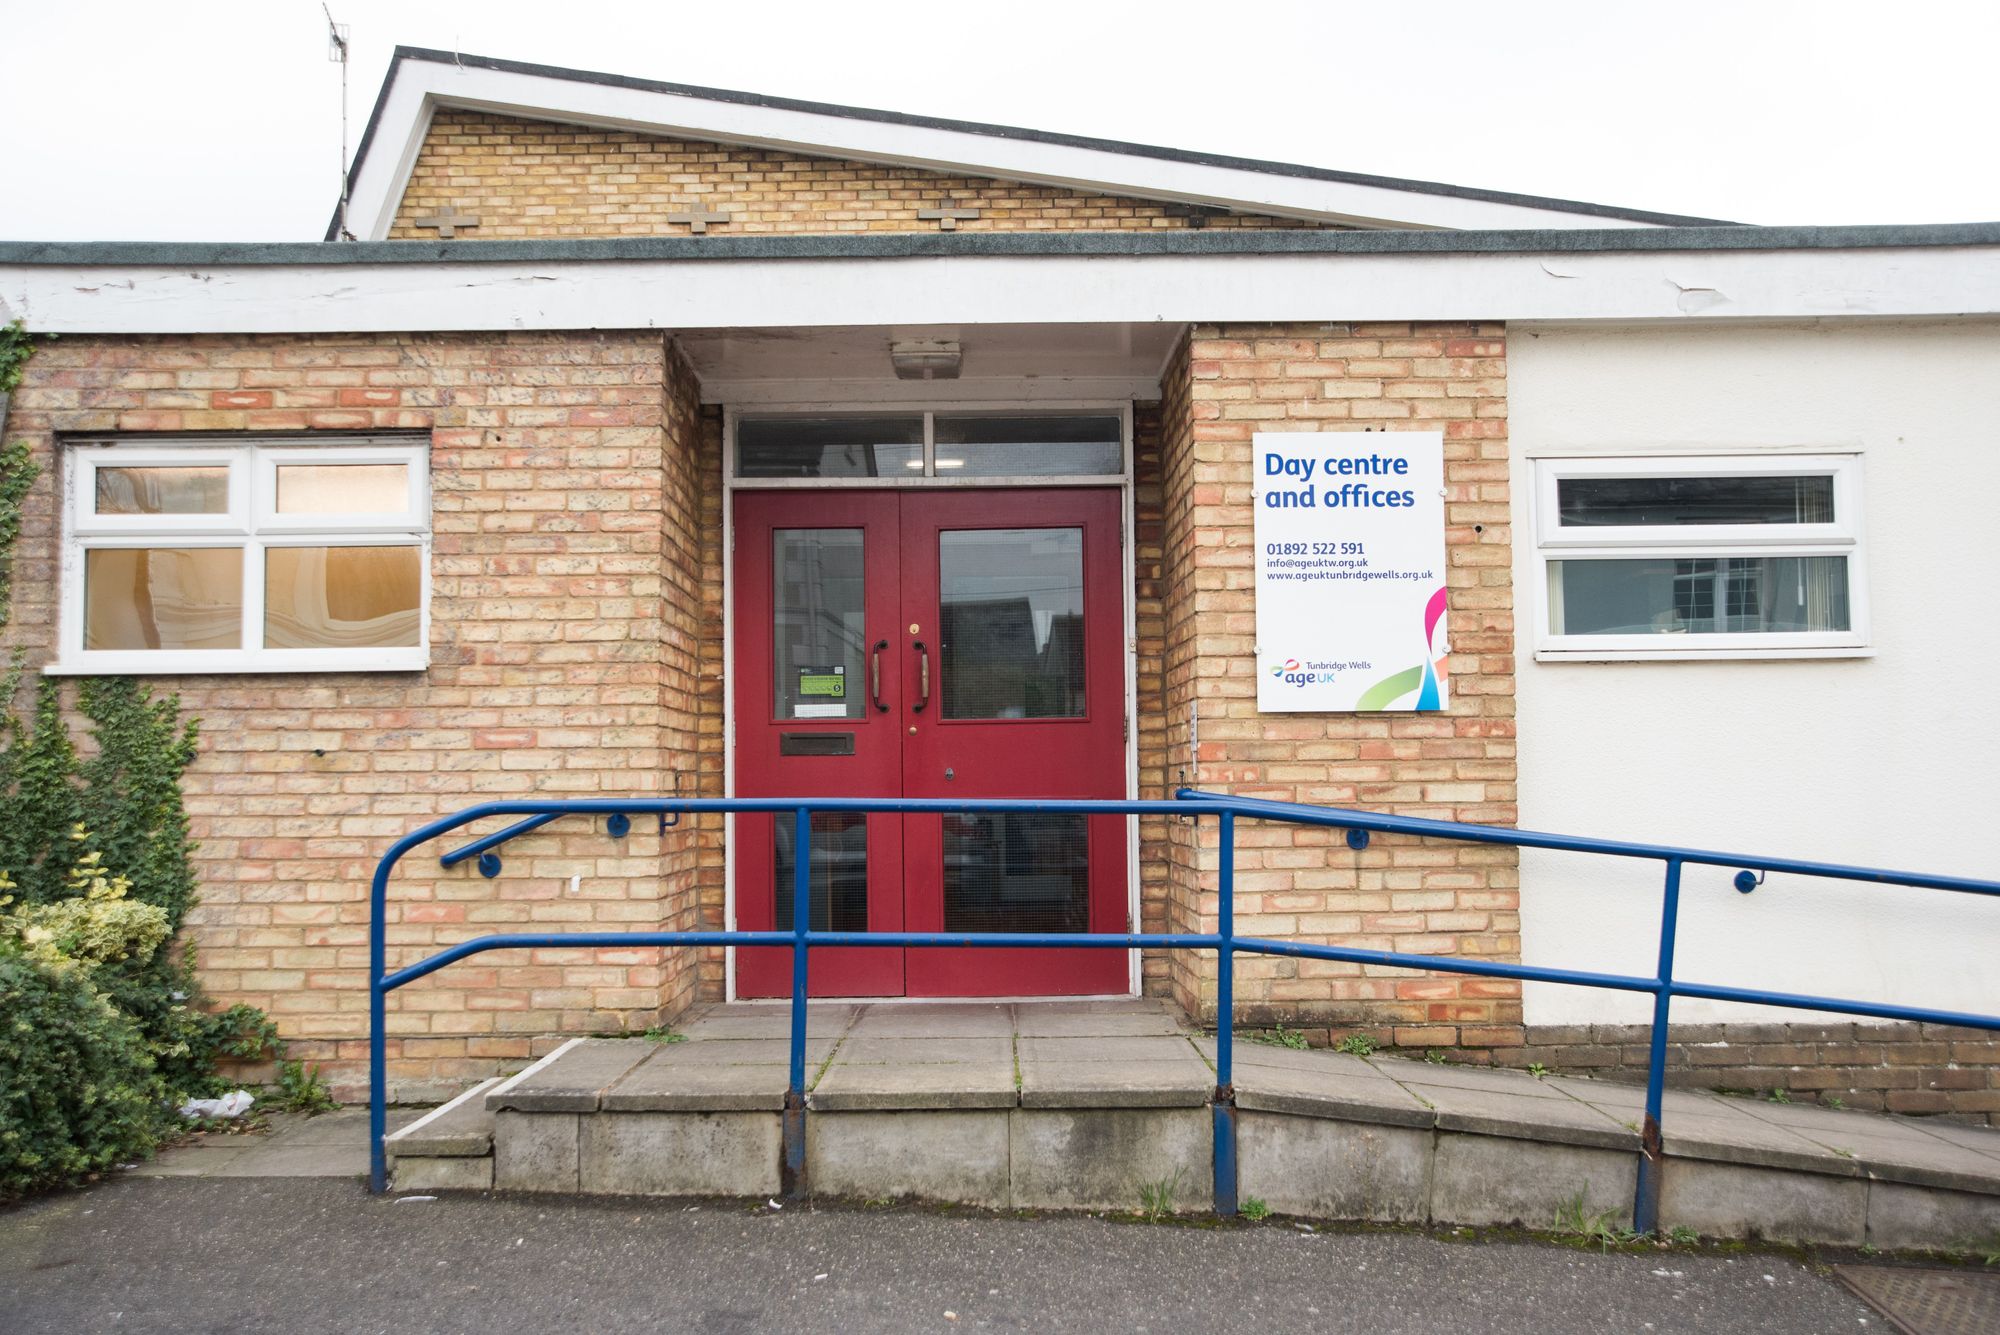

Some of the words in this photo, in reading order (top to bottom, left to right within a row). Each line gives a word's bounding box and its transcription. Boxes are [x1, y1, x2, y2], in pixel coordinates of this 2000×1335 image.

[1265, 453, 1316, 482] Day
[1324, 454, 1408, 475] centre
[1265, 484, 1316, 508] and
[1324, 484, 1415, 507] offices
[1267, 543, 1308, 555] 01892
[1313, 543, 1336, 554] 522
[1341, 542, 1364, 554] 591
[1267, 559, 1368, 569] info@ageuktw.org.uk
[1267, 570, 1433, 582] www.ageuktunbridgewells.org.uk
[1306, 661, 1347, 671] Tunbridge
[1349, 661, 1371, 669] Wells
[1285, 672, 1315, 687] age
